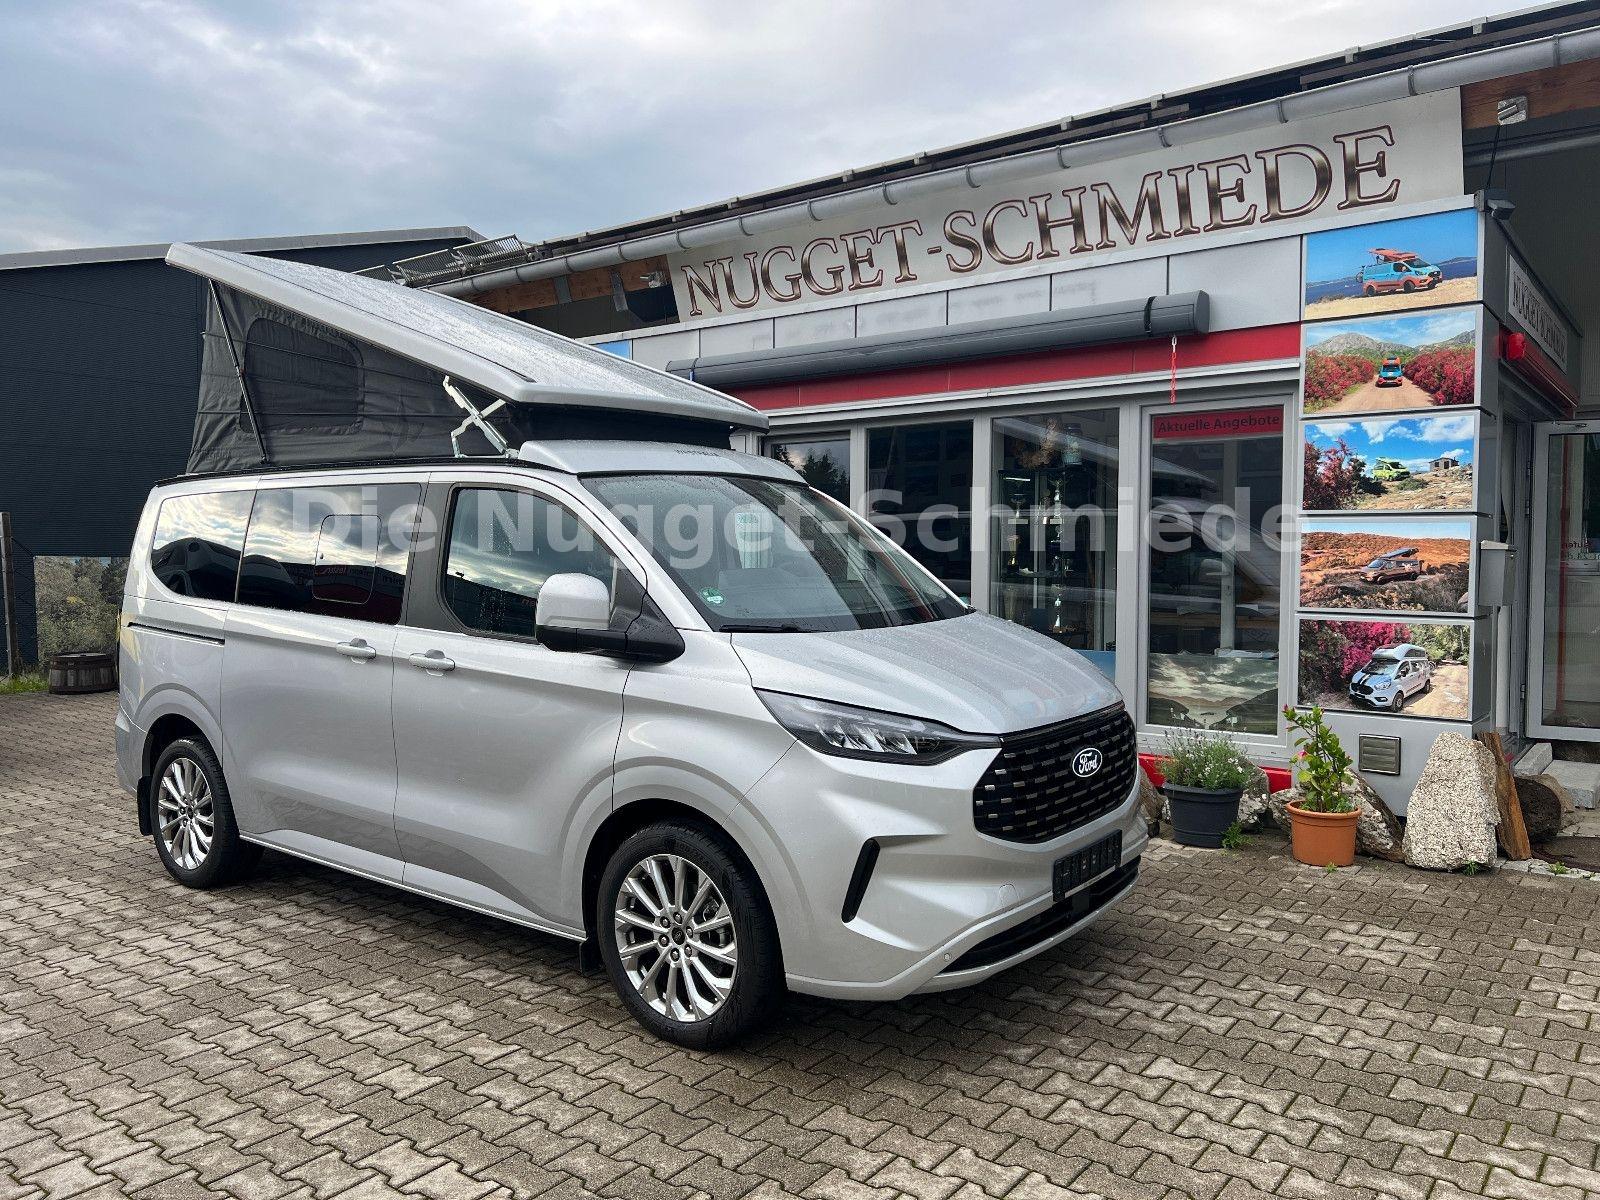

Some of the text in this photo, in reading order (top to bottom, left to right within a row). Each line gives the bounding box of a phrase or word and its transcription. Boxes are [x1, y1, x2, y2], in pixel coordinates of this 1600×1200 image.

[681, 125, 1400, 316] NUGGET-SCHMIEDE
[1158, 415, 1280, 432] Aktuelle Angebote
[1078, 751, 1098, 774] Ford
